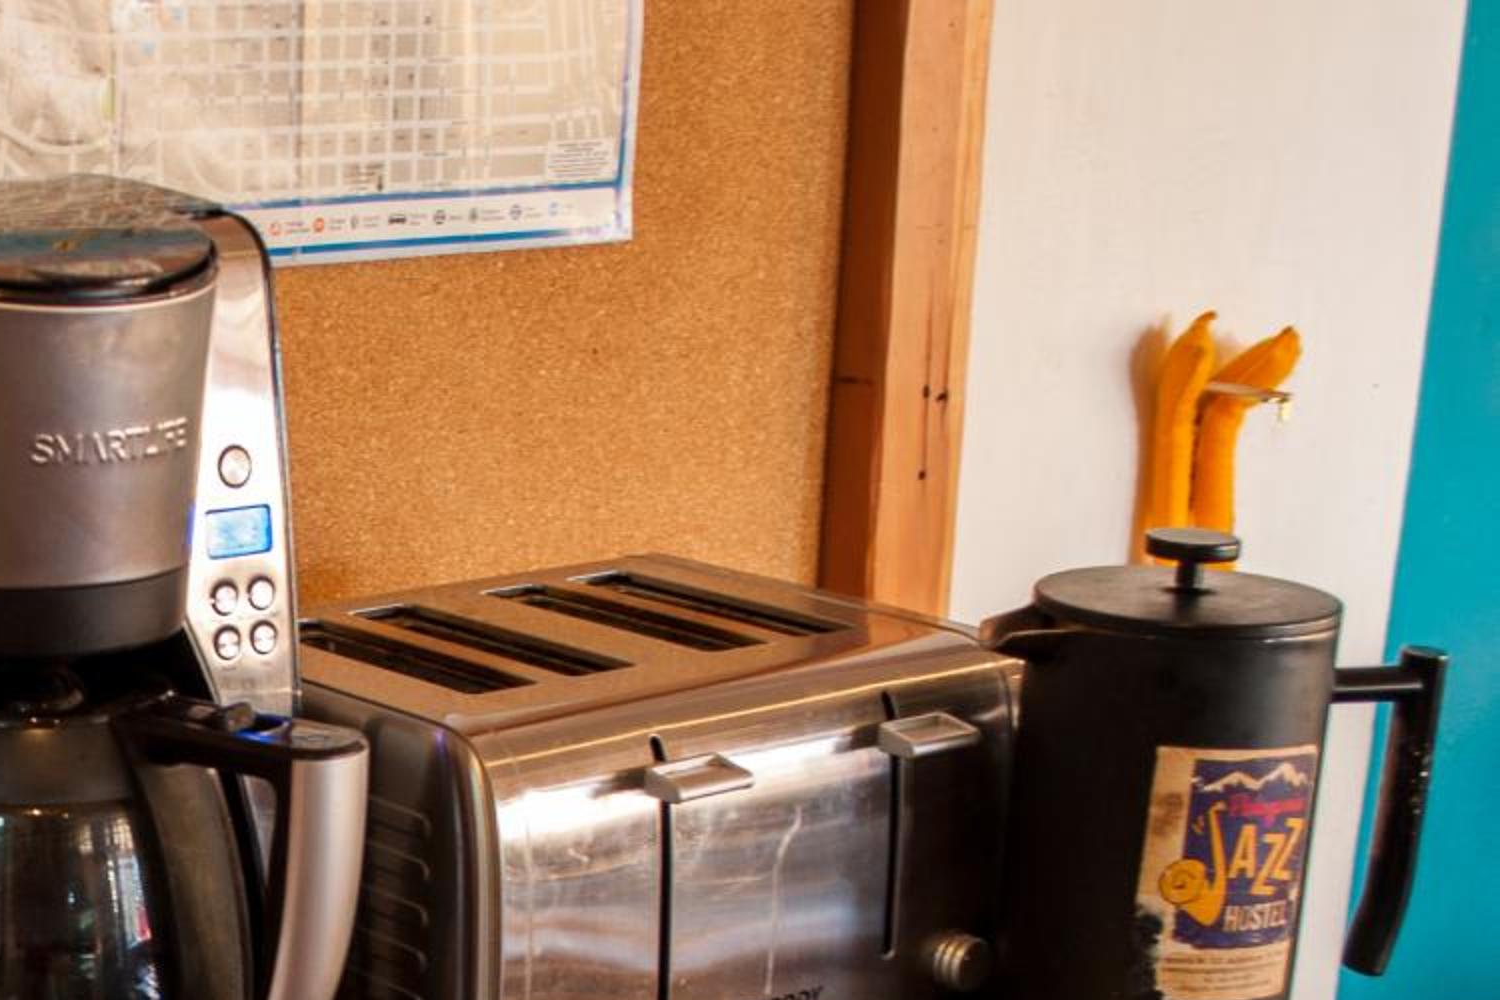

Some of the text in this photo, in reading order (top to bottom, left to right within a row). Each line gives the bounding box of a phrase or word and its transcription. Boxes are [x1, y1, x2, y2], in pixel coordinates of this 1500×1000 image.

[30, 416, 188, 464] SMARTLIFE
[1159, 799, 1307, 927] JAZZ
[1222, 901, 1288, 932] HOSTEL
